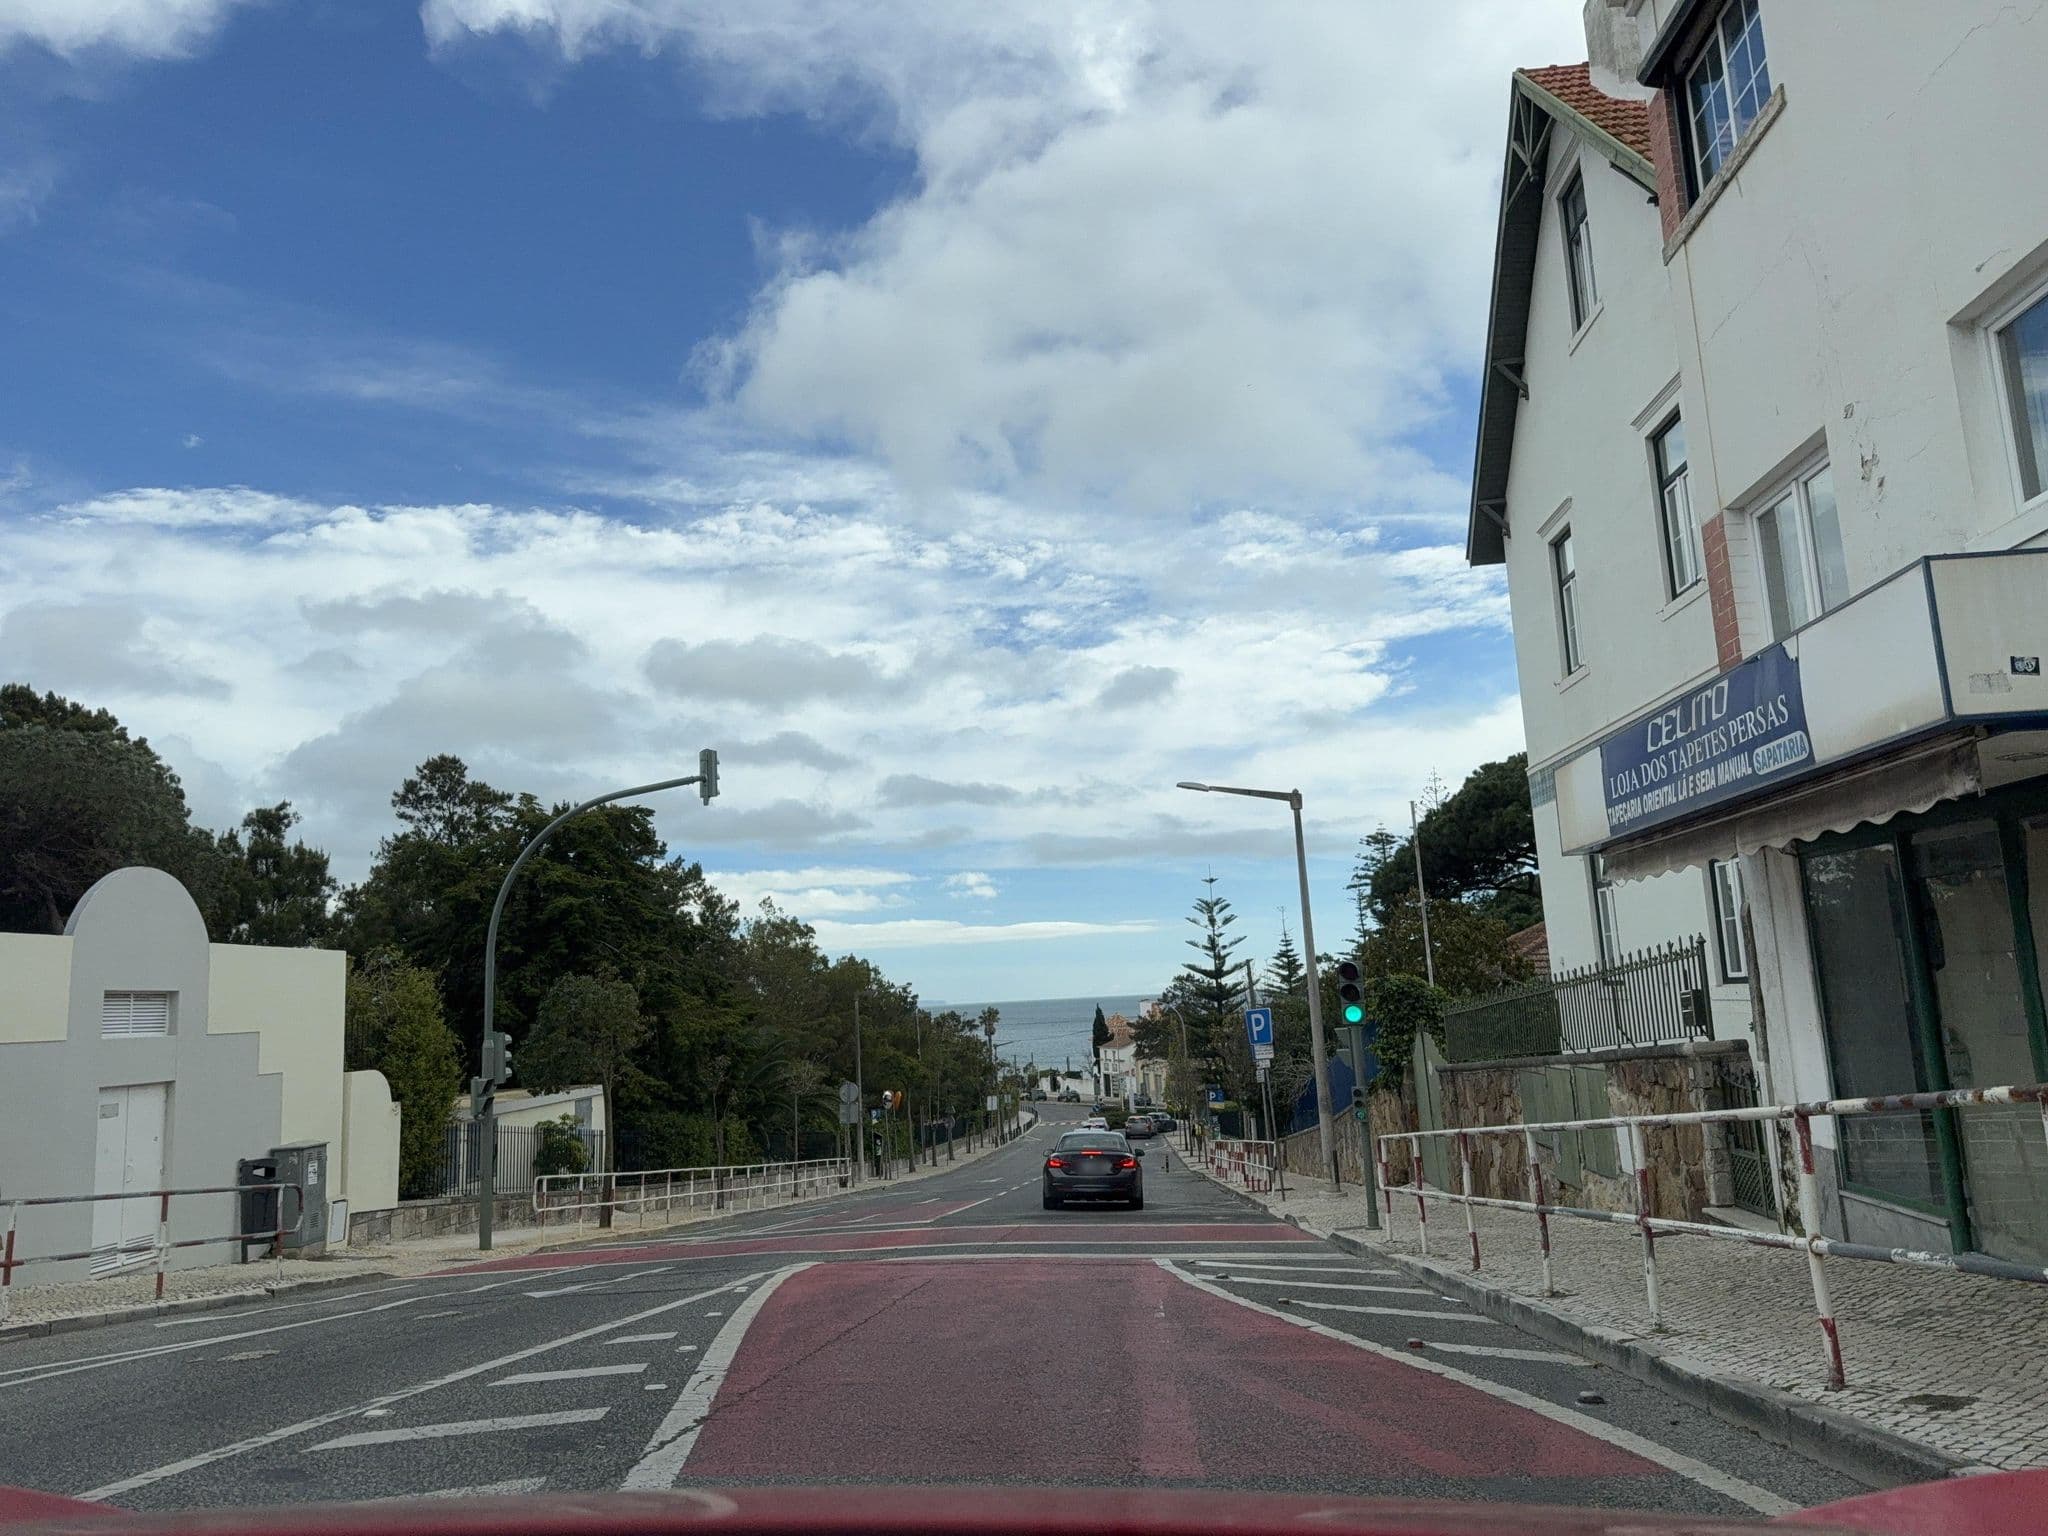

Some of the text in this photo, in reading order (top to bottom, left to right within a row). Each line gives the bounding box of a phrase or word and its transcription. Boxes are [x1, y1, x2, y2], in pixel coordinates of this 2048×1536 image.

[1610, 694, 1789, 799] LOJA DOS TAPETES PERSAS
[1647, 679, 1728, 752] CELITO
[1755, 733, 1808, 771] SAPATARIA
[1608, 796, 1642, 826] TAPEÇARIA
[1643, 783, 1677, 814] ORIENTAL
[1689, 775, 1694, 797] E
[1695, 766, 1716, 794] SEDA
[1717, 751, 1752, 786] MANUAL
[1251, 1013, 1265, 1041] P
